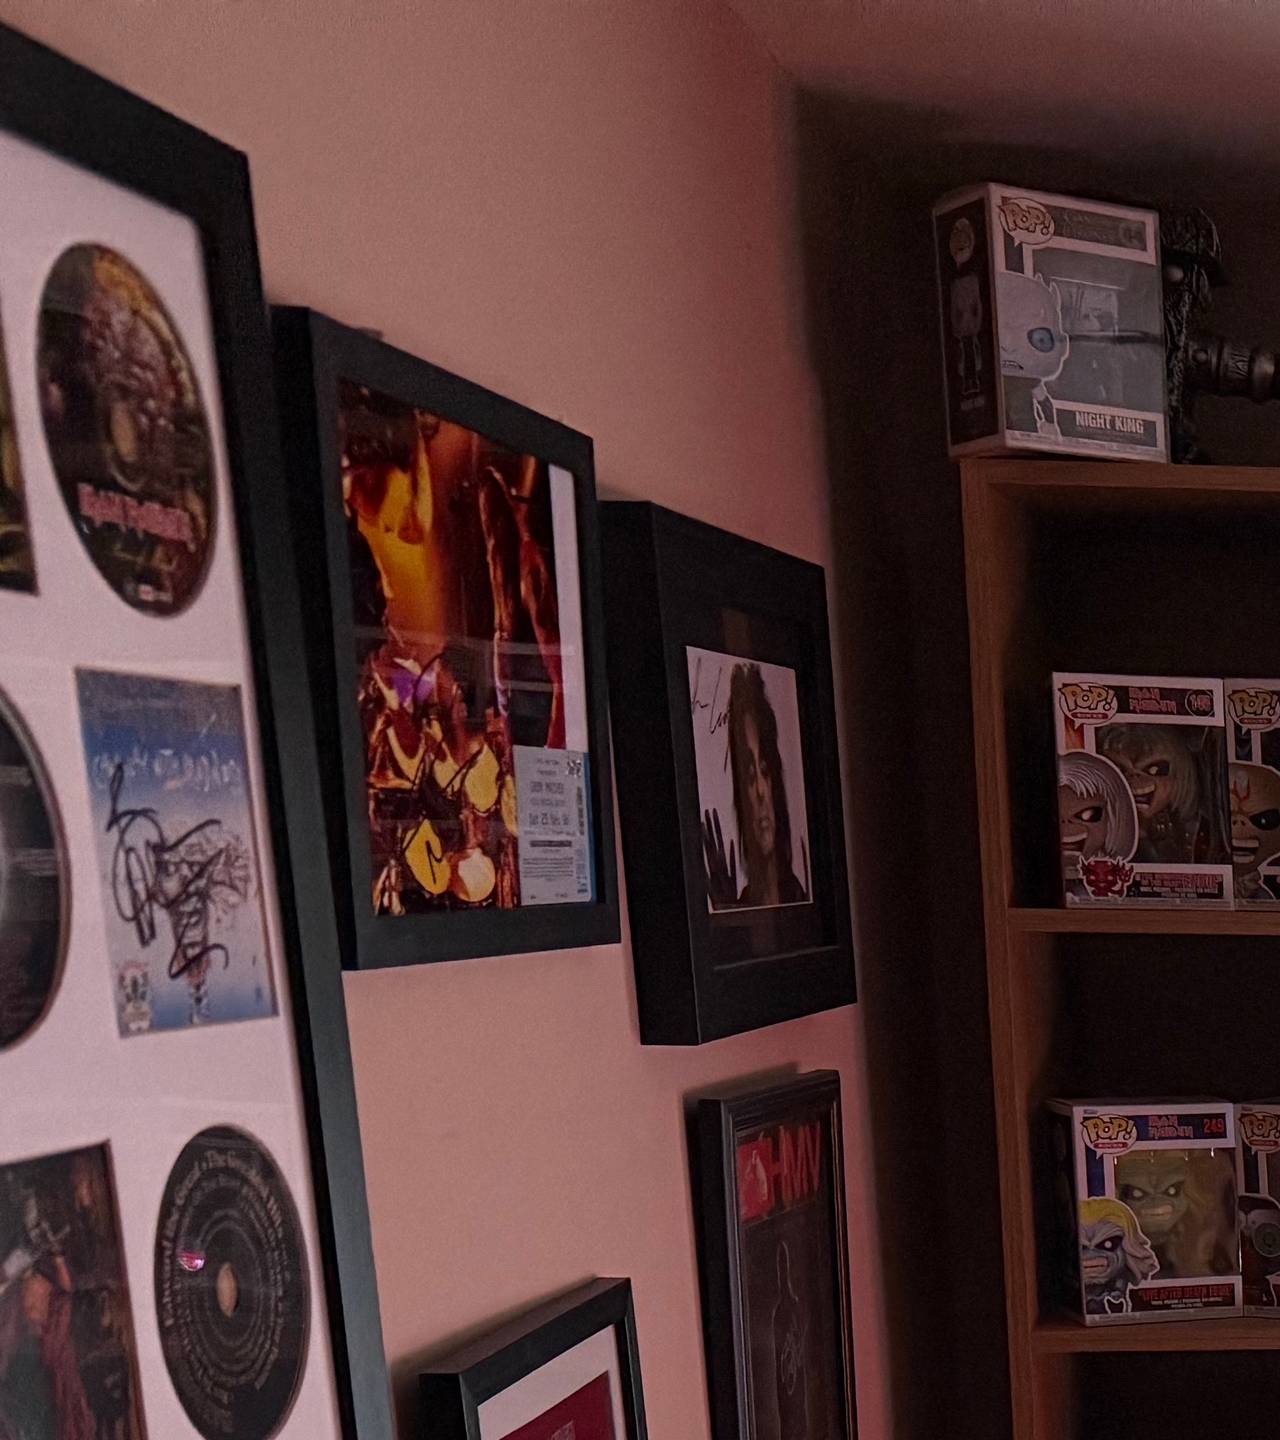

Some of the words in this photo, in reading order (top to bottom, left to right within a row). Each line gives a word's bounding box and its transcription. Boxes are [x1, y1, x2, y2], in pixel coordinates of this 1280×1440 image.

[997, 201, 1050, 236] POP!
[1075, 411, 1111, 430] NIGHT
[1114, 416, 1145, 434] KING
[1058, 684, 1115, 711] POP!
[1227, 690, 1280, 717] POP!
[1081, 1116, 1135, 1142] POP!
[1203, 1118, 1225, 1134] 249
[771, 1120, 821, 1208] HMV
